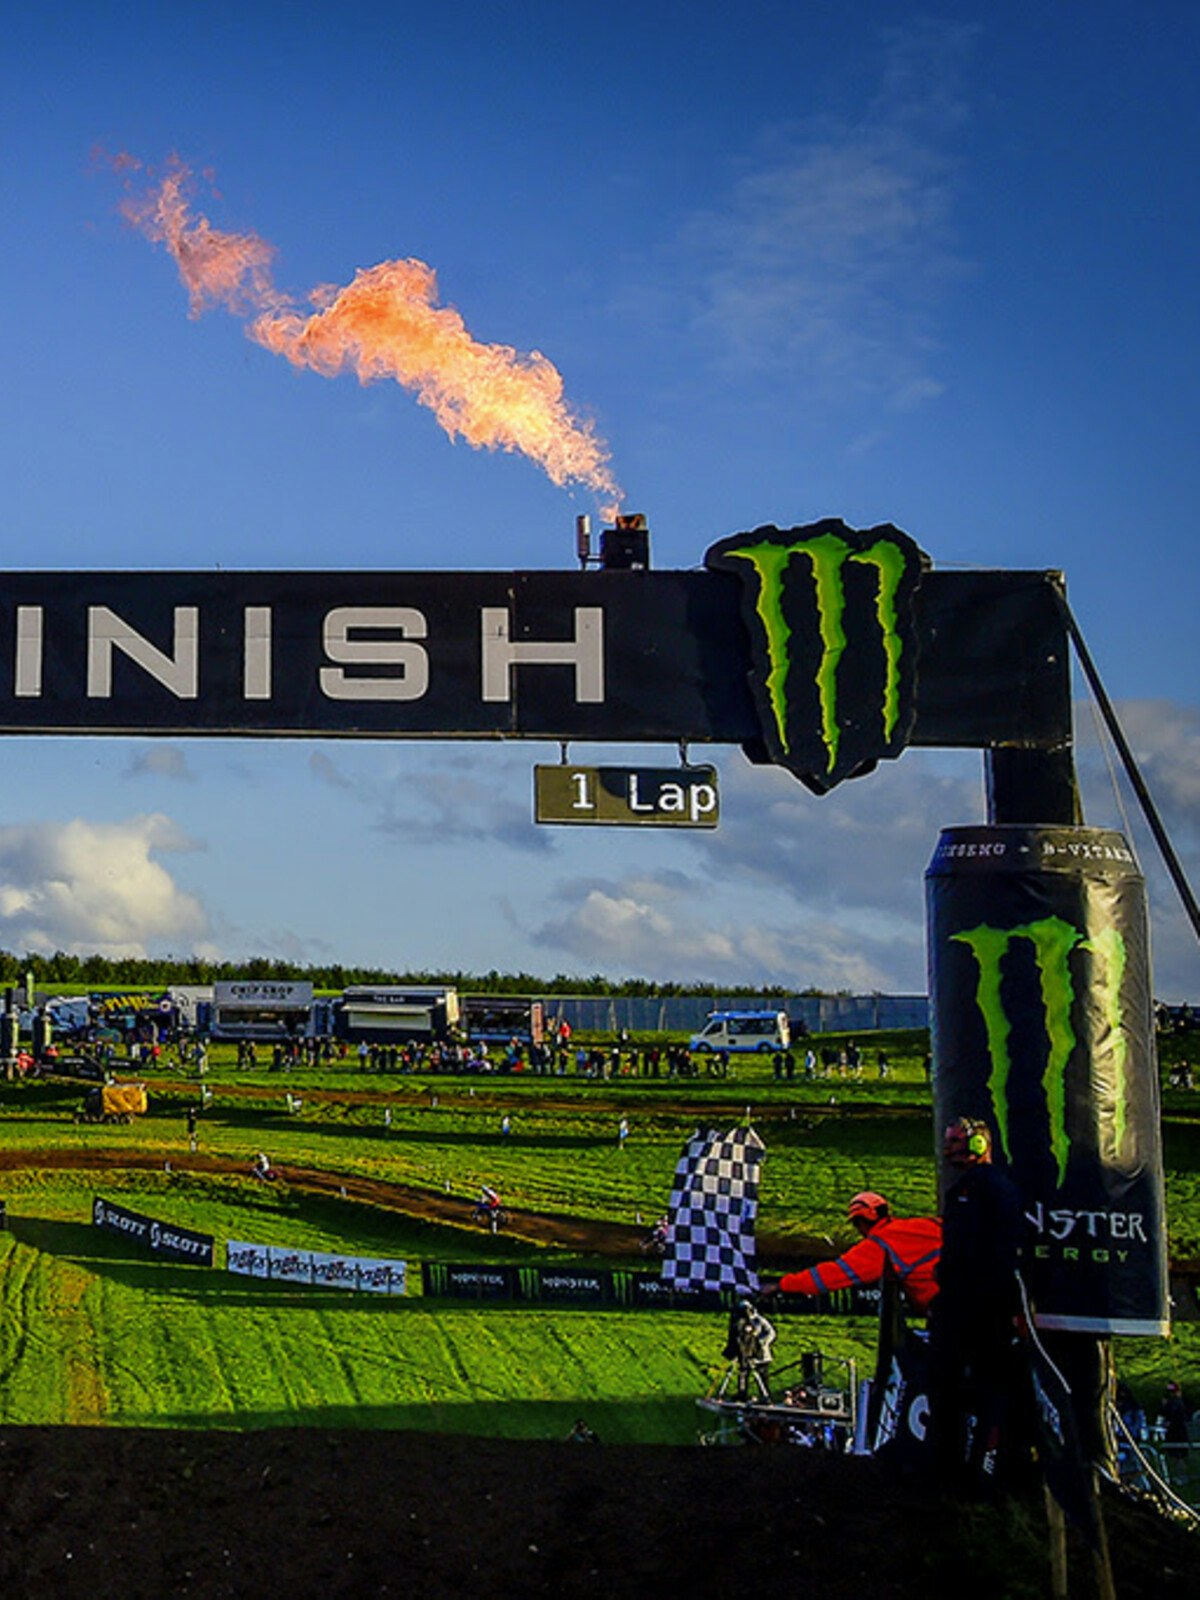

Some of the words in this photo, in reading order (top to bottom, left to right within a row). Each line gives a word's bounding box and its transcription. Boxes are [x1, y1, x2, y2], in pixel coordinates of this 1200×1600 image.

[571, 772, 595, 809] 1
[628, 773, 717, 822] Lap
[106, 1210, 146, 1236] SCOTT
[1024, 1201, 1148, 1243] NSTER
[162, 1231, 211, 1256] SCOTT
